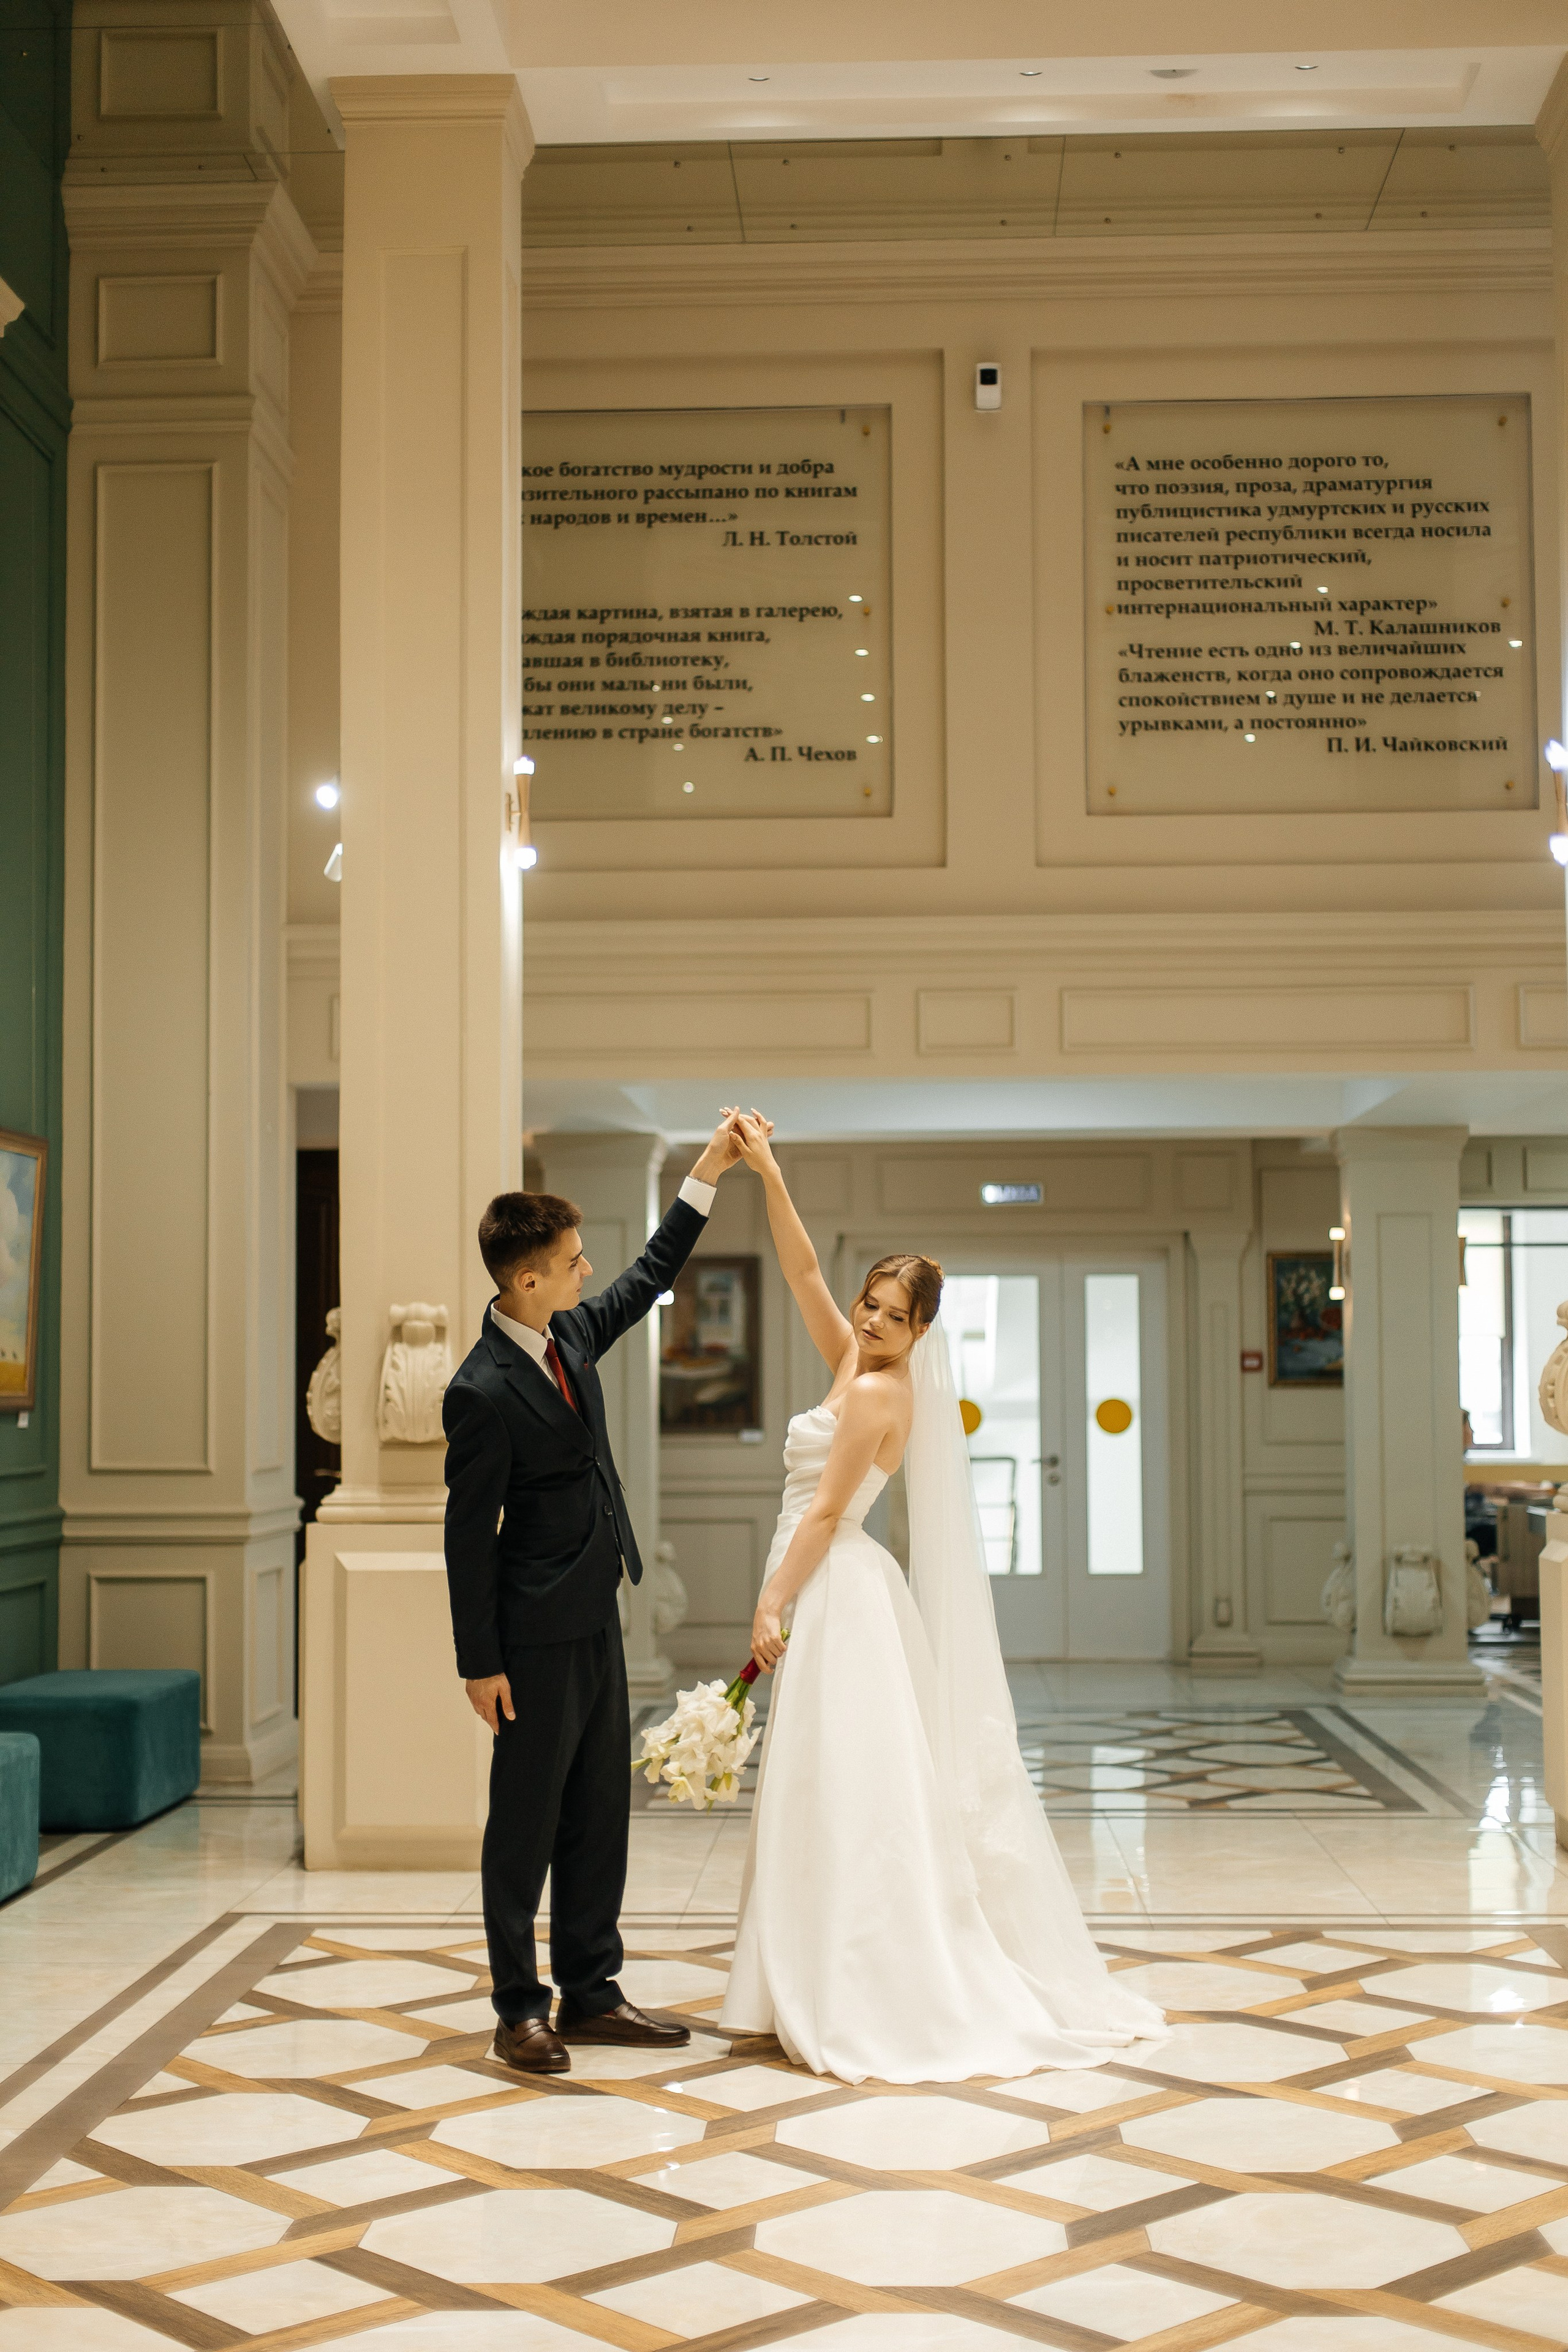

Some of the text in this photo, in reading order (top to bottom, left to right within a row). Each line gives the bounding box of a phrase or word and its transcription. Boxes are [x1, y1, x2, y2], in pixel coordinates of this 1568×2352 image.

[559, 461, 654, 477] богатство
[659, 464, 753, 480] мудрости
[759, 464, 772, 475] и
[776, 458, 835, 479] добра
[1114, 454, 1389, 473] «А мне особенно дорого то,
[644, 488, 749, 504] рассыпано
[755, 487, 779, 499] по
[784, 486, 858, 499] книгам
[1114, 478, 1433, 498] что поэзия, проза, драматургия
[1115, 501, 1490, 522] публицистика удмуртских и русских
[529, 513, 611, 530] народов
[617, 513, 630, 524] и
[721, 530, 858, 547] Л. Н. Толстой
[1116, 525, 1491, 546] писателей республики всегда носила
[1116, 549, 1372, 570] и носит патриотический,
[1117, 574, 1302, 595] просветительский
[576, 608, 663, 625] картина,
[669, 607, 733, 619] взятая
[739, 607, 750, 619] в
[755, 605, 843, 623] галерею,
[1117, 598, 1438, 619] интернациональный характер»
[1314, 620, 1501, 636] М. Т. Калашников
[582, 631, 701, 649] порядочная
[707, 630, 771, 644] книга,
[1118, 641, 1466, 659] «Чтение есть одно из величайших
[590, 657, 600, 668] в
[606, 652, 729, 671] библиотеку,
[557, 680, 595, 692] они
[601, 680, 657, 692] малы
[662, 680, 687, 690] ни
[693, 675, 753, 693] были,
[1118, 666, 1504, 684] блаженств, когда оно сопровождается
[1118, 692, 1260, 707] спокойствием
[1283, 693, 1336, 709] душе
[1342, 693, 1355, 704] и
[1361, 692, 1385, 704] не
[1390, 691, 1478, 706] делается
[560, 704, 656, 720] великому
[663, 703, 708, 720] делу
[602, 728, 614, 739] в
[617, 727, 684, 743] стране
[688, 723, 783, 739] богатств»
[1118, 717, 1366, 735] урывками, а постоянно»
[1327, 736, 1508, 753] П. И. Чайковский
[744, 745, 858, 763] А. П. Чехов
